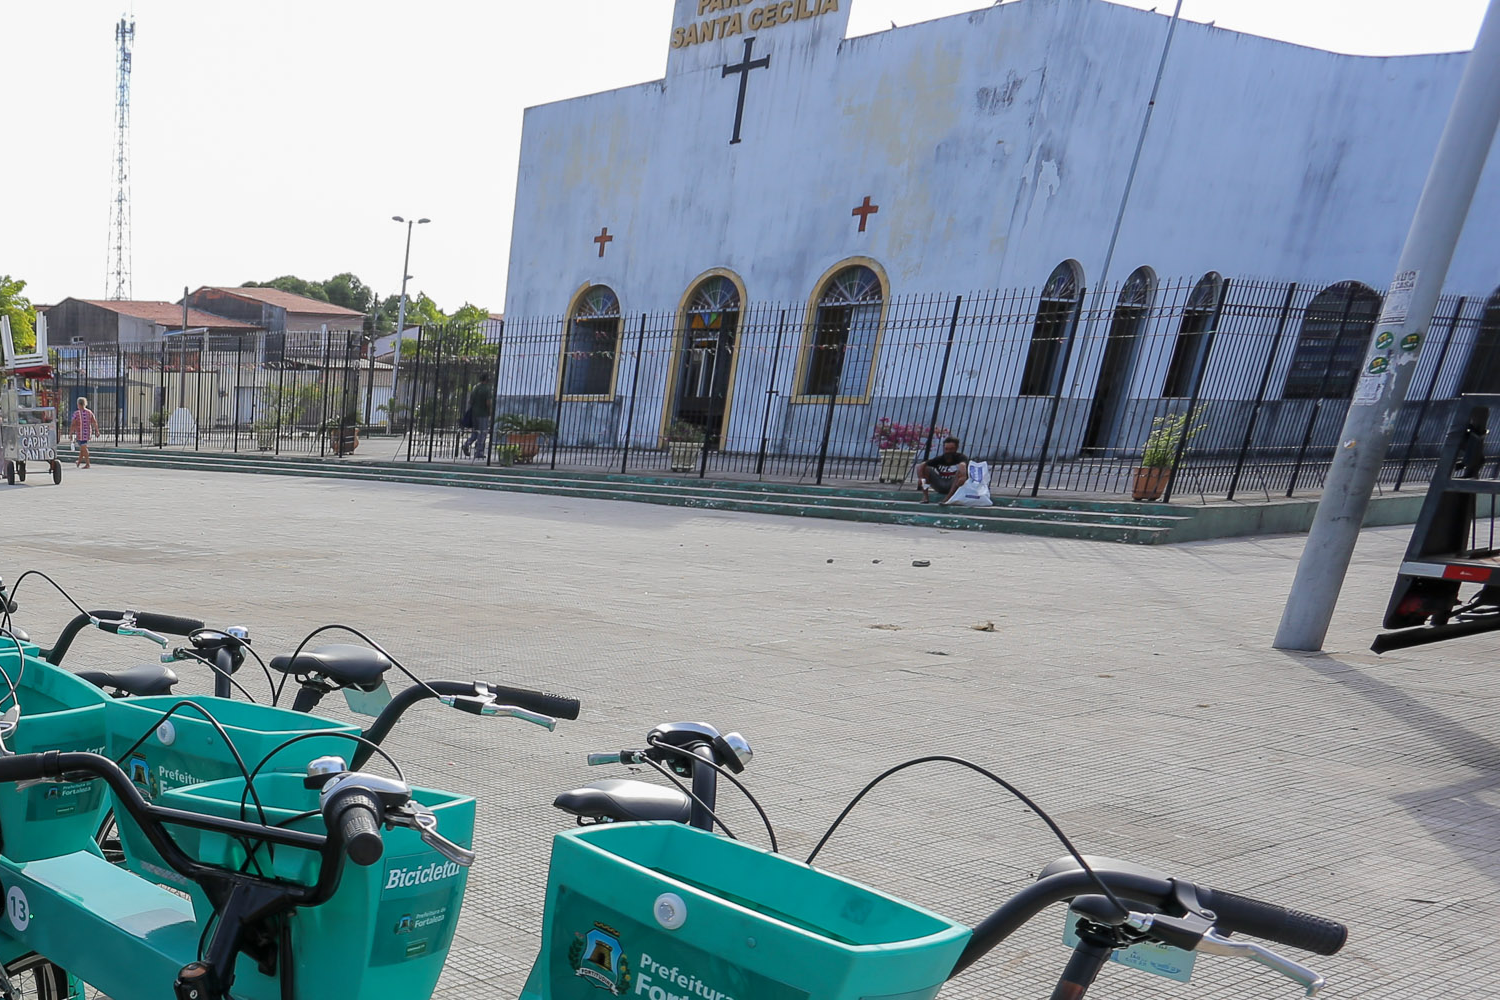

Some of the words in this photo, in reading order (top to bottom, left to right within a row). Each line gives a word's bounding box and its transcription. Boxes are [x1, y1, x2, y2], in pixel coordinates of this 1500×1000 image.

[671, 12, 743, 49] SANTA
[40, 425, 49, 436] DE
[22, 436, 48, 448] CAPIM
[19, 448, 55, 461] SANTO
[158, 765, 205, 785] Prefeitu
[10, 896, 27, 924] 13
